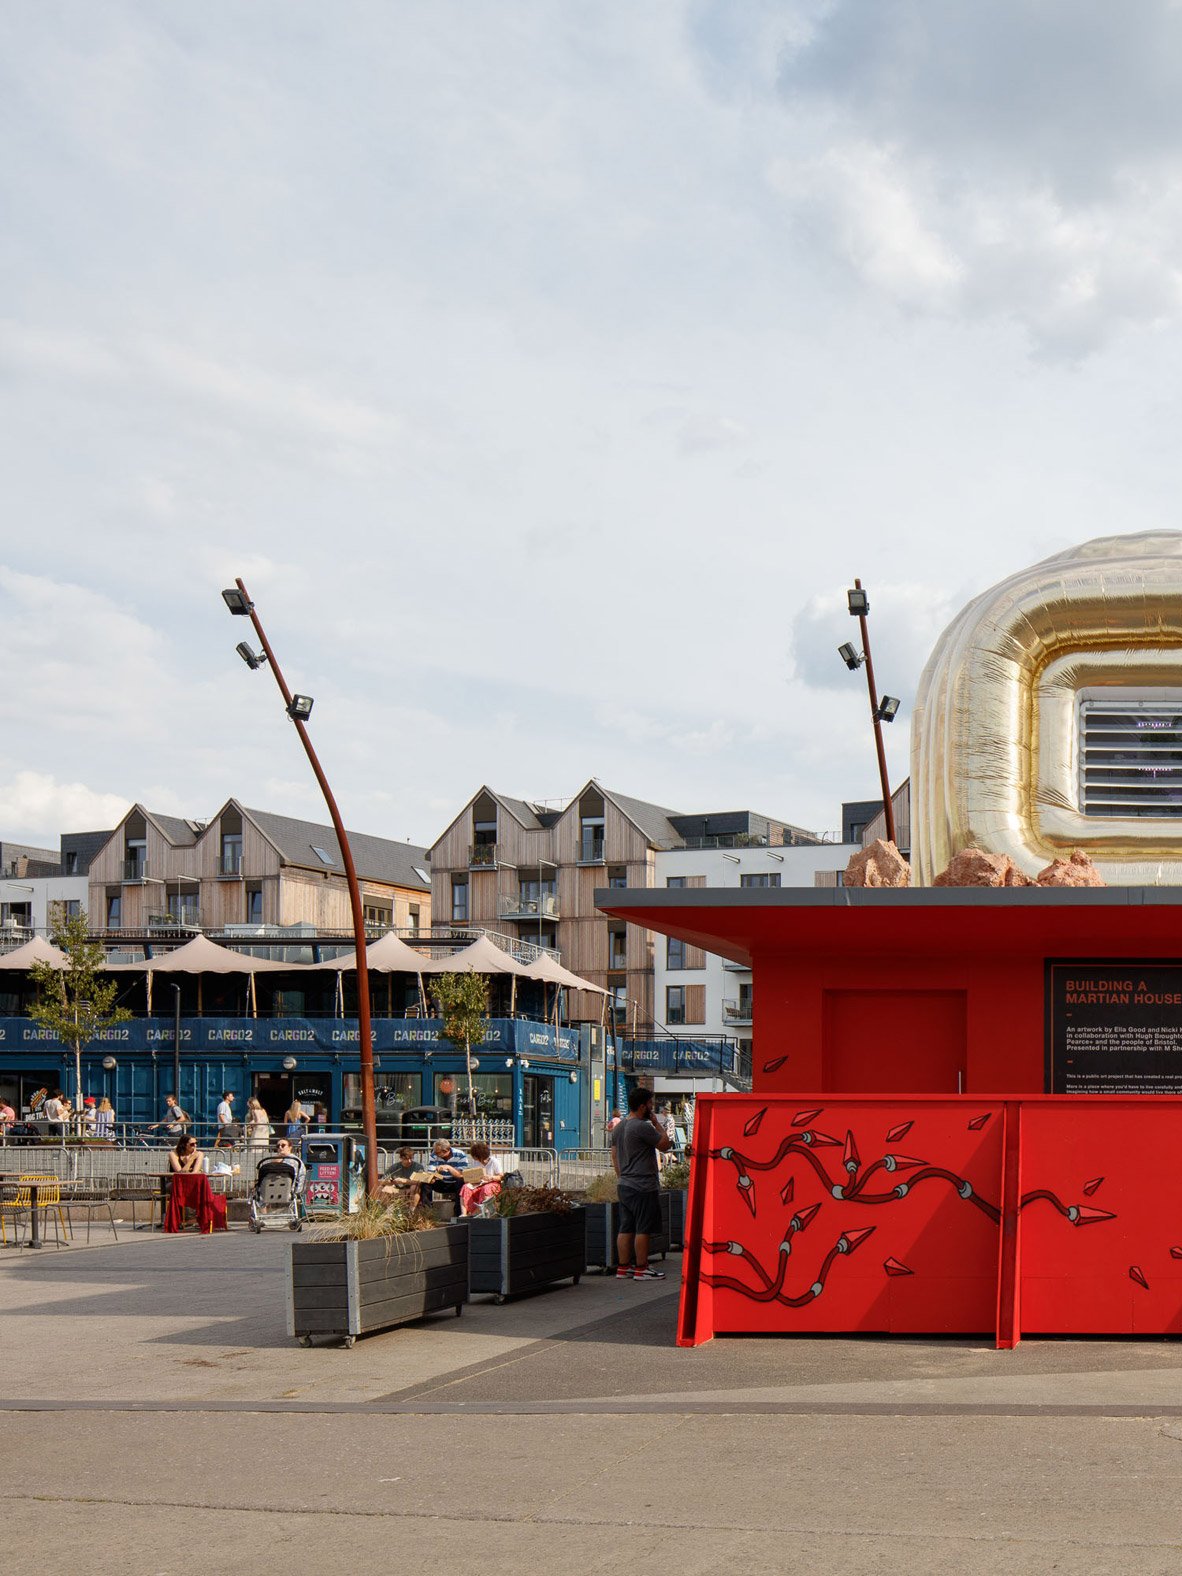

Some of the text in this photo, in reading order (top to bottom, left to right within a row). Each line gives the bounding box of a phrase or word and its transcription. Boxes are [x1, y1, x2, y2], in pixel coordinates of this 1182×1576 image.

[1066, 980, 1148, 991] BUILDING A
[1066, 993, 1182, 1004] MARTIAN HOUSE
[23, 1029, 59, 1040] CARGO
[92, 1029, 129, 1040] ARGO2
[208, 1029, 253, 1041] CARGO2
[270, 1029, 315, 1041] CARGO2
[332, 1030, 377, 1041] CARG2
[394, 1030, 439, 1041] CARGO2
